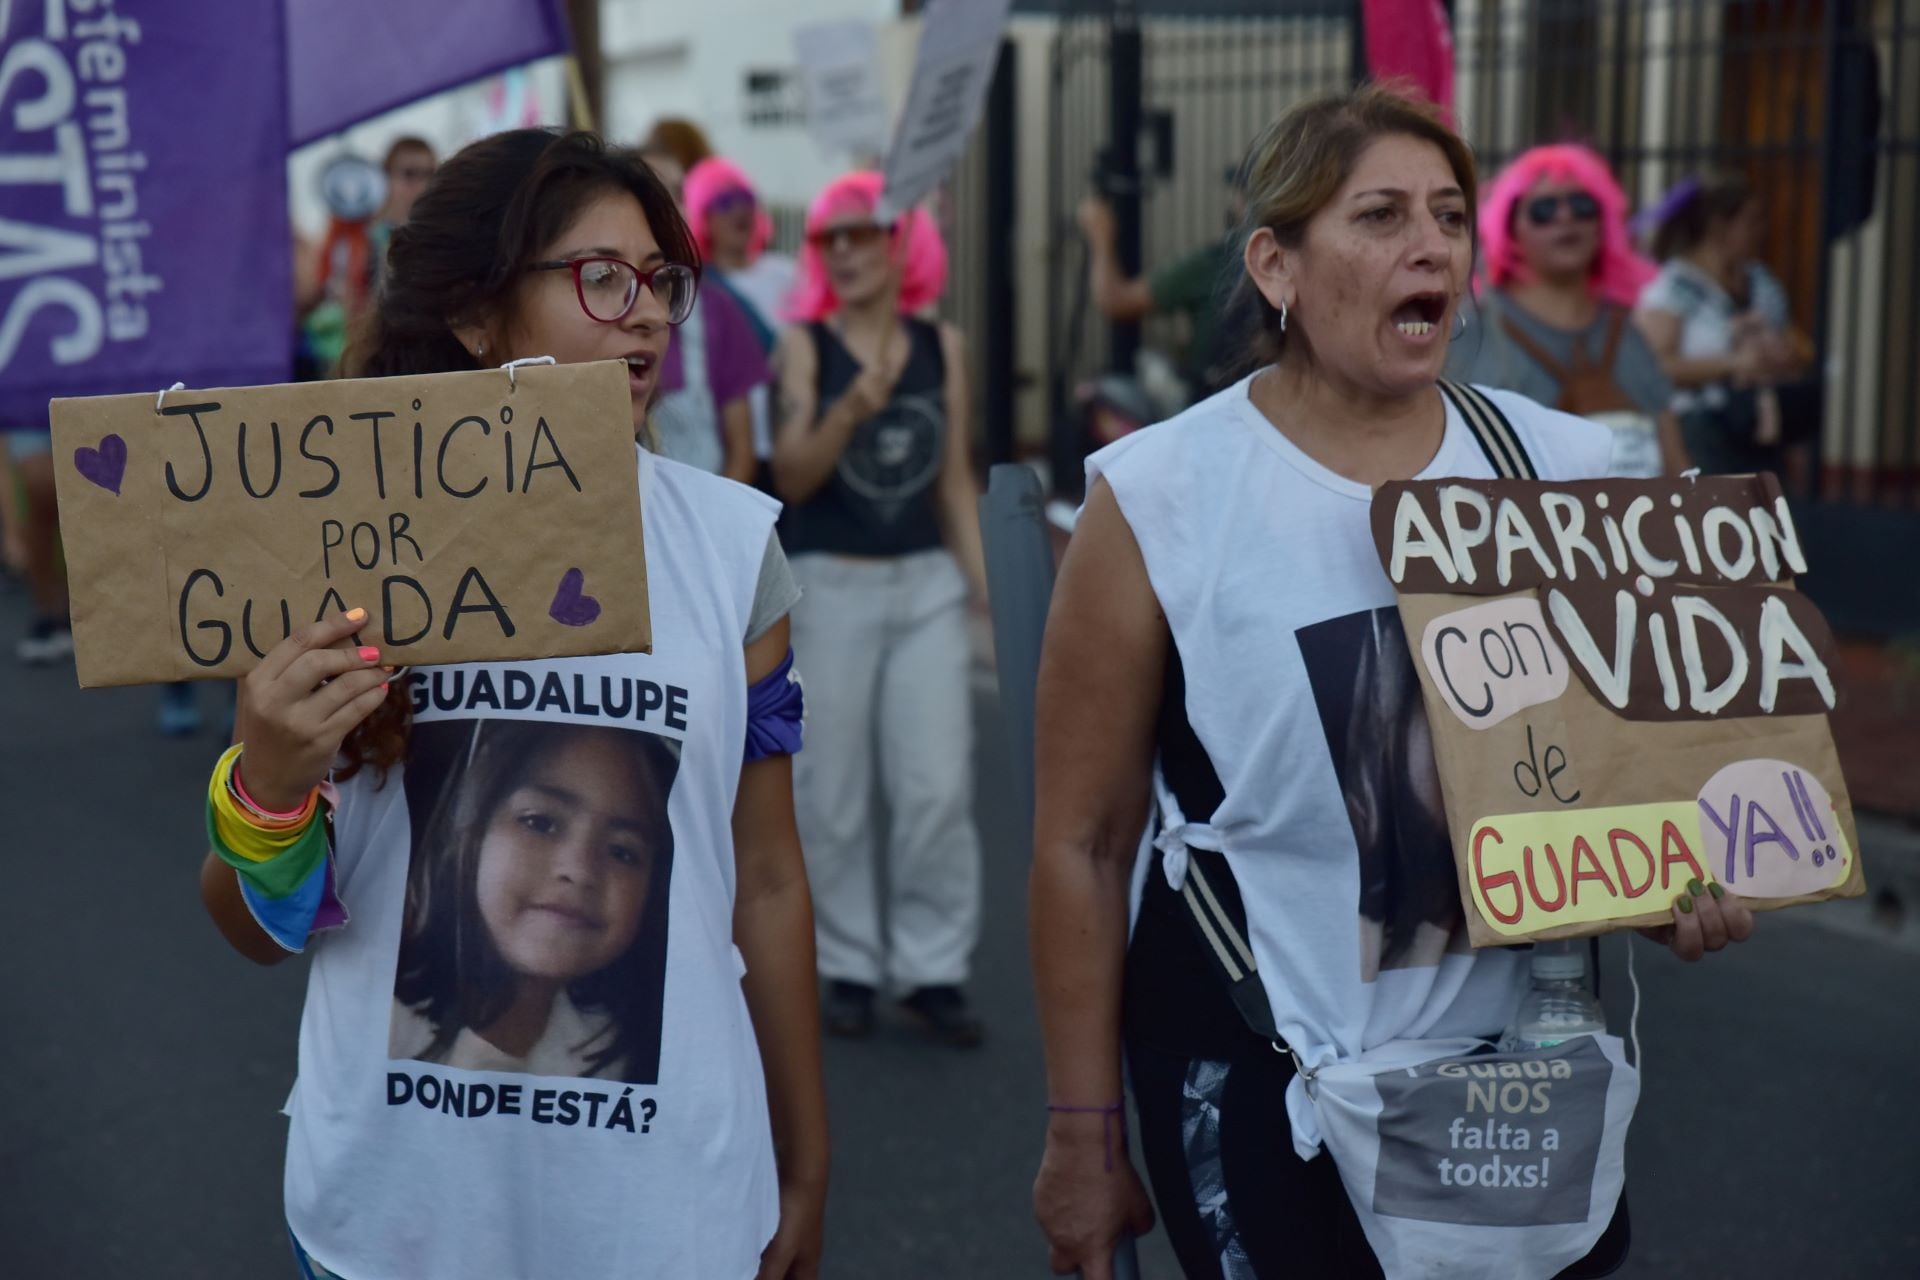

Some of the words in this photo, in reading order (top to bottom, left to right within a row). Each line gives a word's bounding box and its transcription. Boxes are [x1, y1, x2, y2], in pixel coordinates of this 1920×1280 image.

[321, 511, 424, 579] POR
[407, 669, 689, 732] GUADALUPE
[1433, 620, 1553, 719] Con
[1512, 724, 1581, 804] de
[1472, 819, 1705, 926] GUADA
[1697, 770, 1837, 884] YA!!
[386, 1072, 522, 1118] DONDE
[531, 1085, 659, 1135] ESTÁ?
[1465, 1080, 1553, 1115] NOS
[1448, 1116, 1531, 1151] falta
[1541, 1128, 1560, 1151] a
[1438, 1155, 1550, 1188] todxs!
